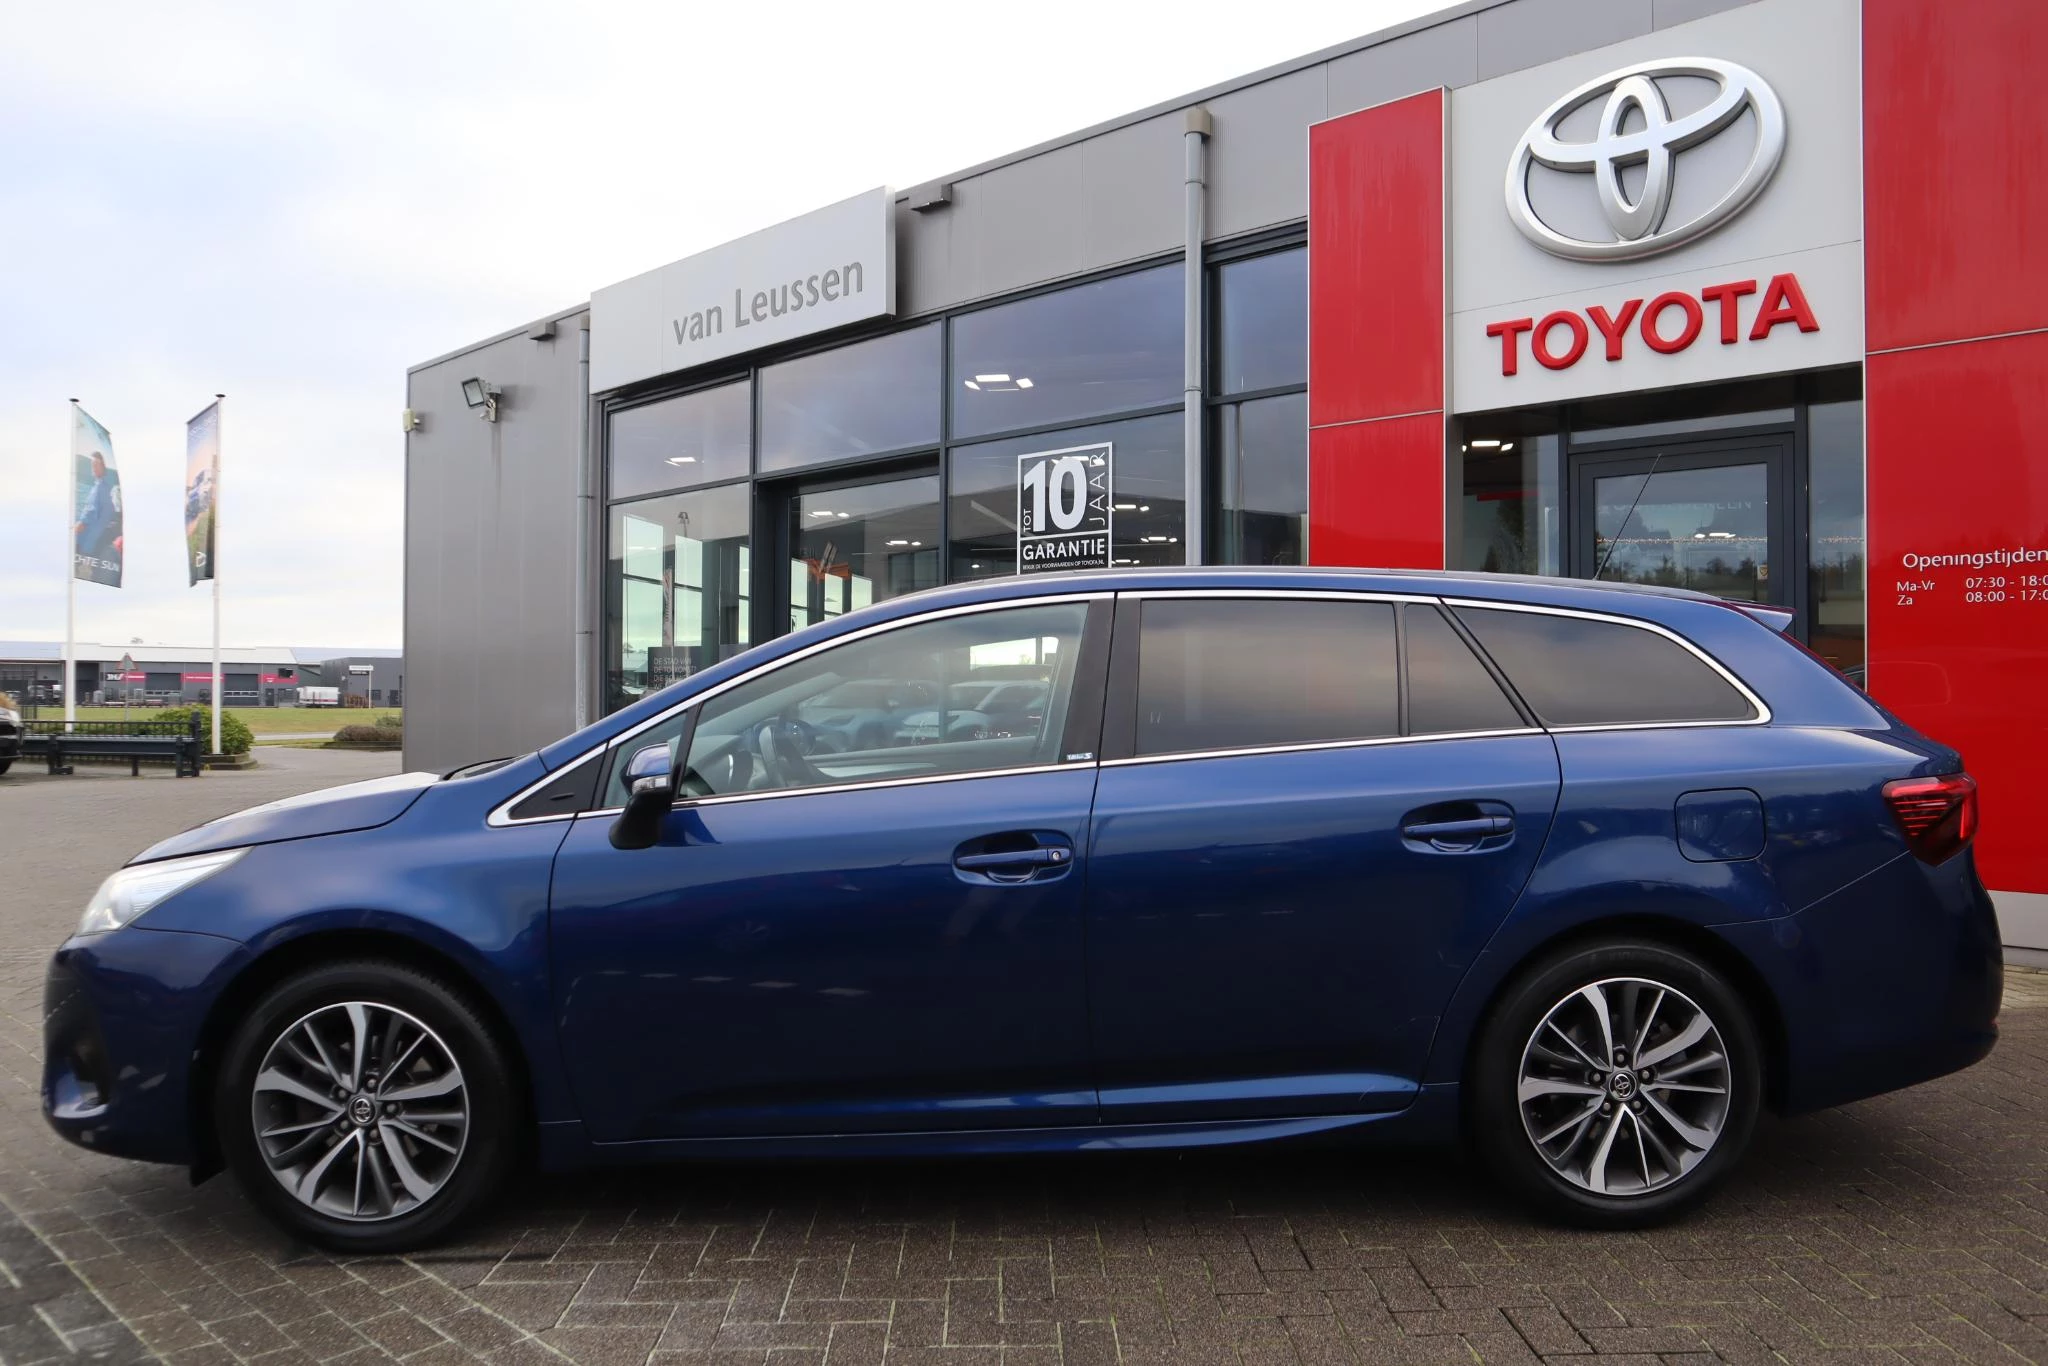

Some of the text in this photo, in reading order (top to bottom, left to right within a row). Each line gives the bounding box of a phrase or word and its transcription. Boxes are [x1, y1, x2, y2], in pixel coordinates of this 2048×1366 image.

[672, 262, 863, 345] van Leussen
[1486, 272, 1820, 376] TOYOTA
[1023, 457, 1087, 532] 10
[1089, 452, 1105, 526] JAAR
[1023, 508, 1031, 532] TOT
[1022, 538, 1105, 561] GARANTIE
[1902, 546, 2048, 572] Openingstijden
[1896, 580, 1935, 592] Ma-Vr
[1965, 576, 2006, 589] 07:30
[1897, 594, 1913, 606] Za
[1965, 590, 2006, 603] 08:00
